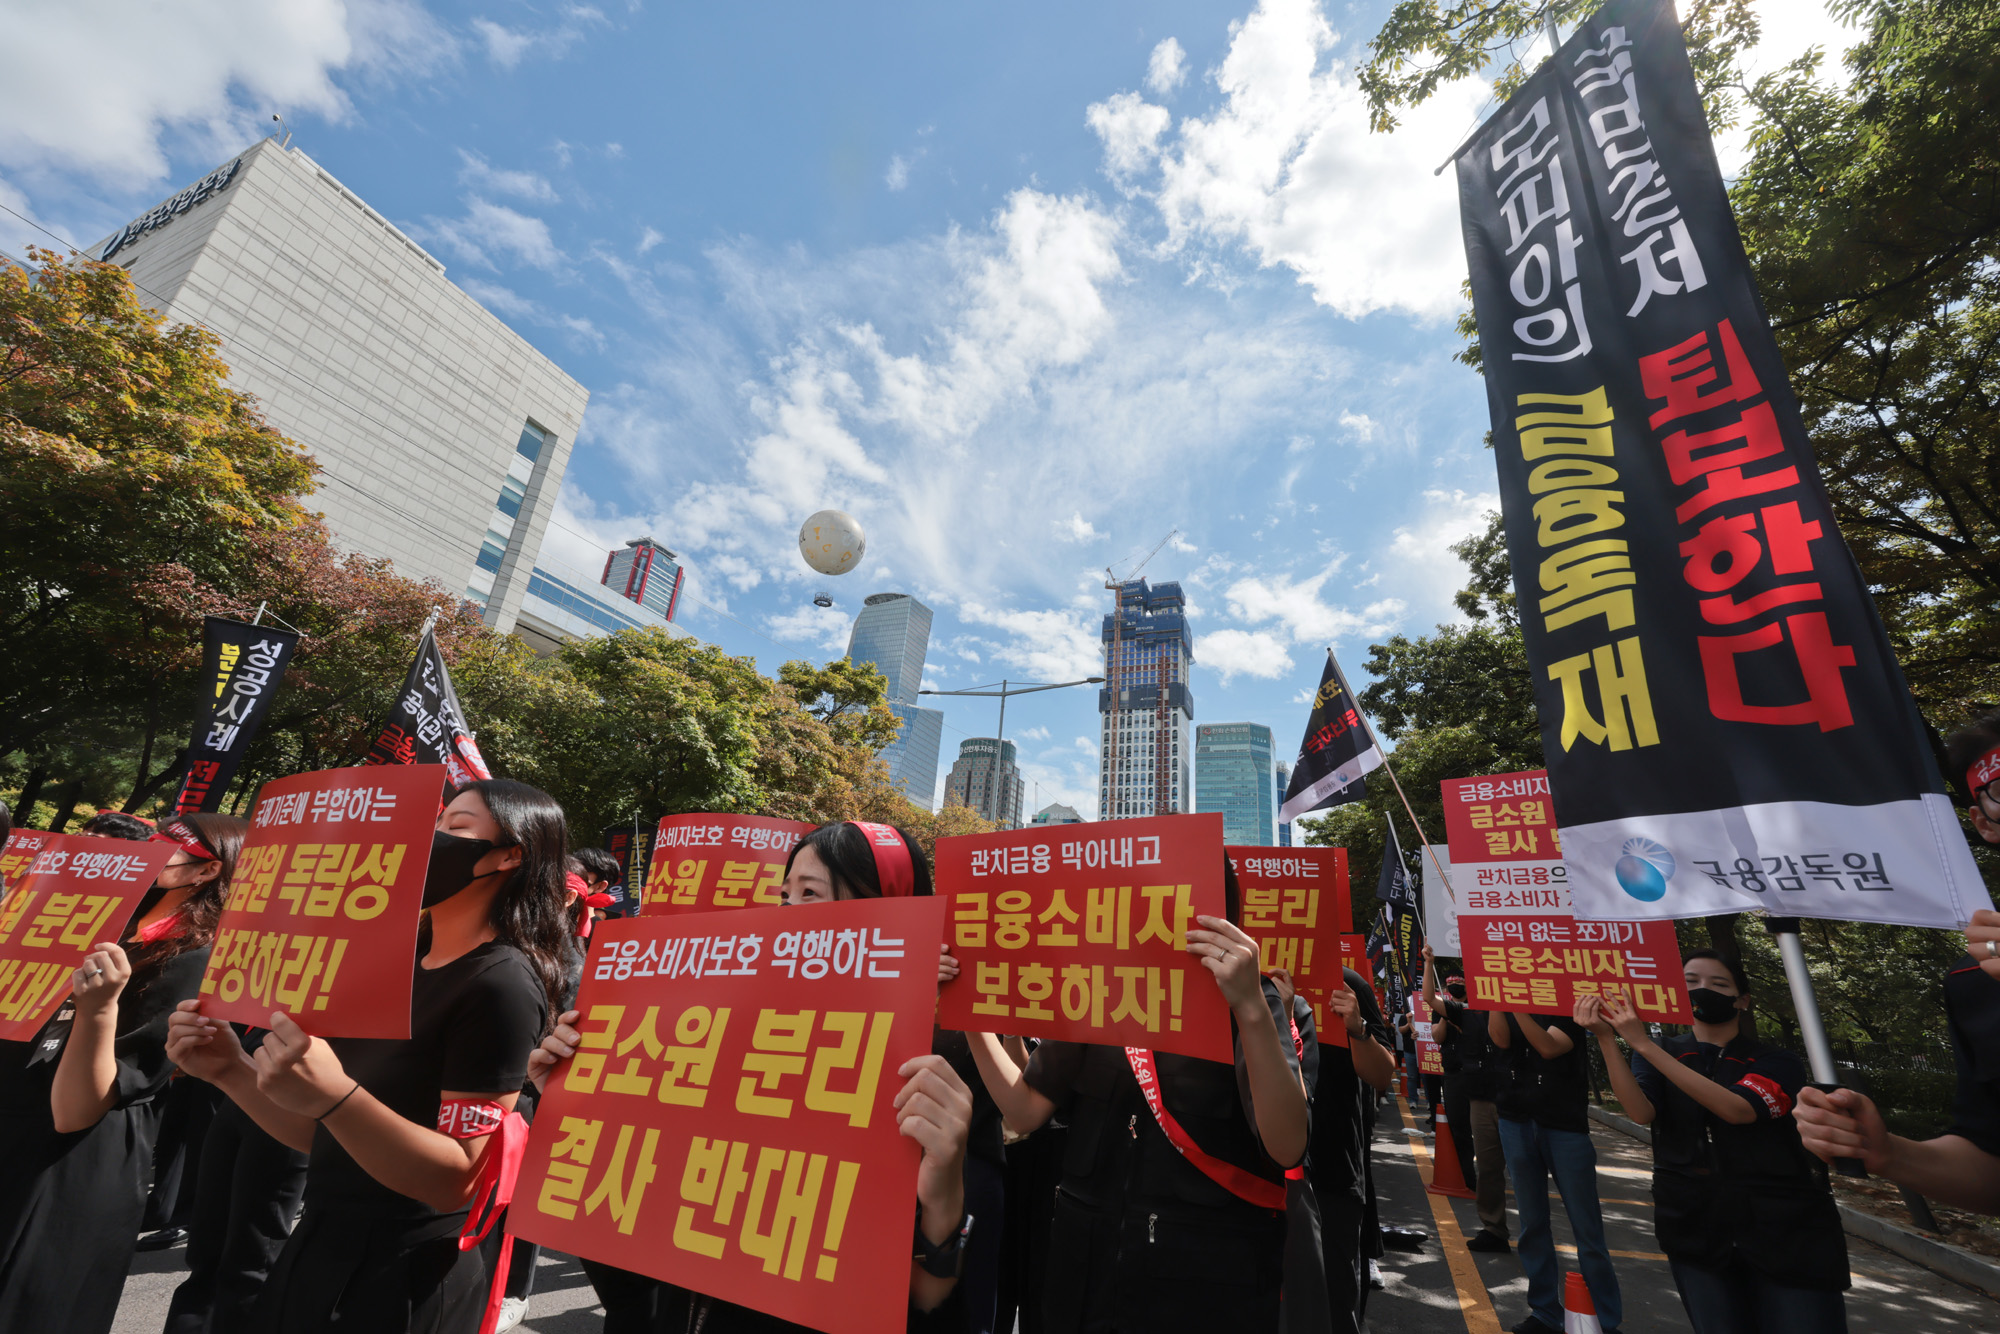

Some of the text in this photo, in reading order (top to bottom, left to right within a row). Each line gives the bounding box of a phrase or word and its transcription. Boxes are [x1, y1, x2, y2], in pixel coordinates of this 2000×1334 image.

[124, 158, 243, 245] 한국산업은행
[1490, 96, 1661, 753] 모피아의 금융독재
[1638, 317, 1857, 733] 퇴보한다
[205, 639, 284, 752] 성공사례
[256, 787, 397, 829] 국제기준에 부합하는
[1469, 800, 1547, 829] 금소원
[970, 835, 1162, 877] 관치금융 막아내고
[1485, 829, 1538, 855] 결사
[69, 852, 148, 882] 역행하는
[278, 843, 408, 921] 독립성
[1245, 858, 1320, 879] 역행하는
[1693, 852, 1894, 893] 금융감독원
[954, 884, 1196, 952] 금융소비자
[1243, 888, 1320, 928] 분리
[1467, 889, 1560, 909] 금융소비자
[21, 892, 124, 952] 분리
[1484, 921, 1523, 942] 실익
[1528, 921, 1571, 943] 없는
[1577, 922, 1645, 945] 쪼개기
[199, 927, 350, 1014] 보장하라!
[594, 928, 905, 981] 금융소비자보호 역행하는
[1251, 937, 1314, 977] 대!
[1481, 946, 1658, 979] 금융소비자는
[972, 961, 1185, 1033] 보호하자!
[1474, 975, 1559, 1007] 피눈물
[563, 1004, 896, 1129] 금소원 분리
[537, 1116, 862, 1283] 결사 반대!
